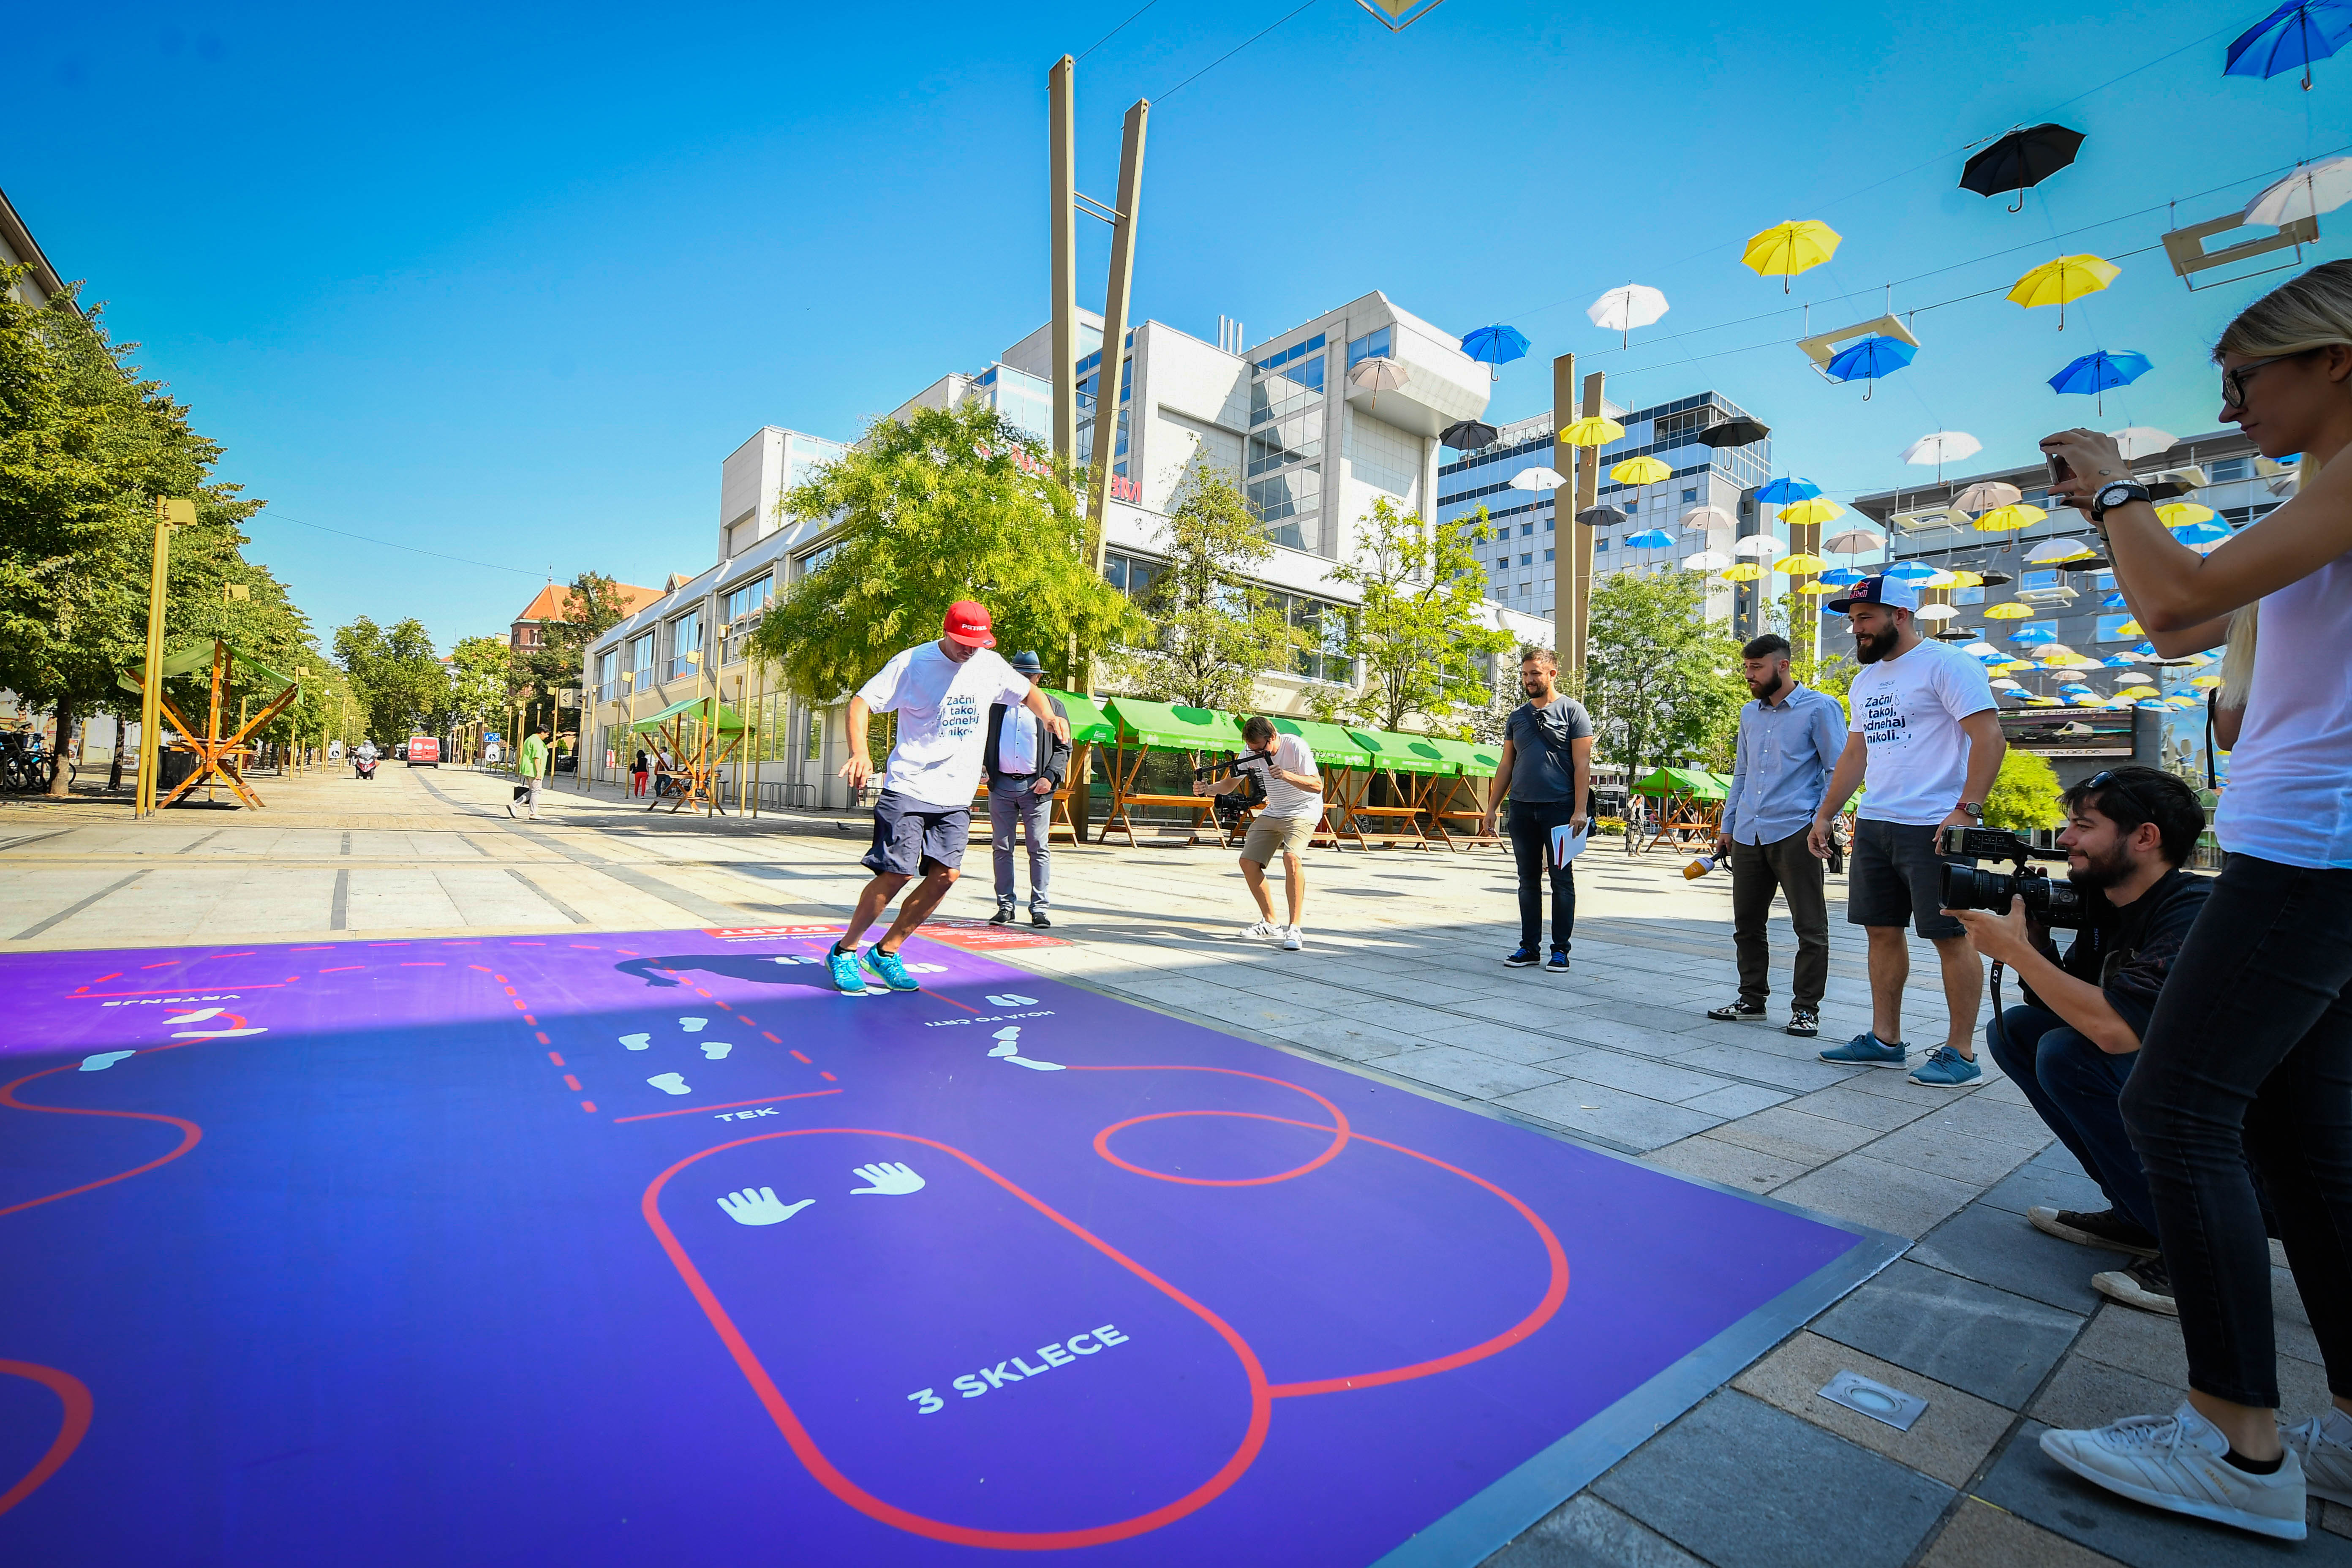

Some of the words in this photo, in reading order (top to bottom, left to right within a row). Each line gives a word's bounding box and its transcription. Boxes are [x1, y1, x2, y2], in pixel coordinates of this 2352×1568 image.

[1110, 474, 1141, 502] BM
[1854, 590, 1867, 598] Bull
[947, 694, 975, 705] Začni
[1865, 693, 1894, 708] Začni
[1868, 704, 1897, 719] takoj,
[1863, 716, 1906, 732] odnehaj
[1867, 730, 1900, 744] nikoli.
[719, 926, 830, 935] START
[101, 994, 241, 1007] VRTENJE
[1004, 1010, 1056, 1020] HOJA
[924, 1018, 972, 1027] ČRTI
[714, 1107, 780, 1122] TEK
[907, 1387, 945, 1414] 3
[952, 1323, 1130, 1399] SKLECE
